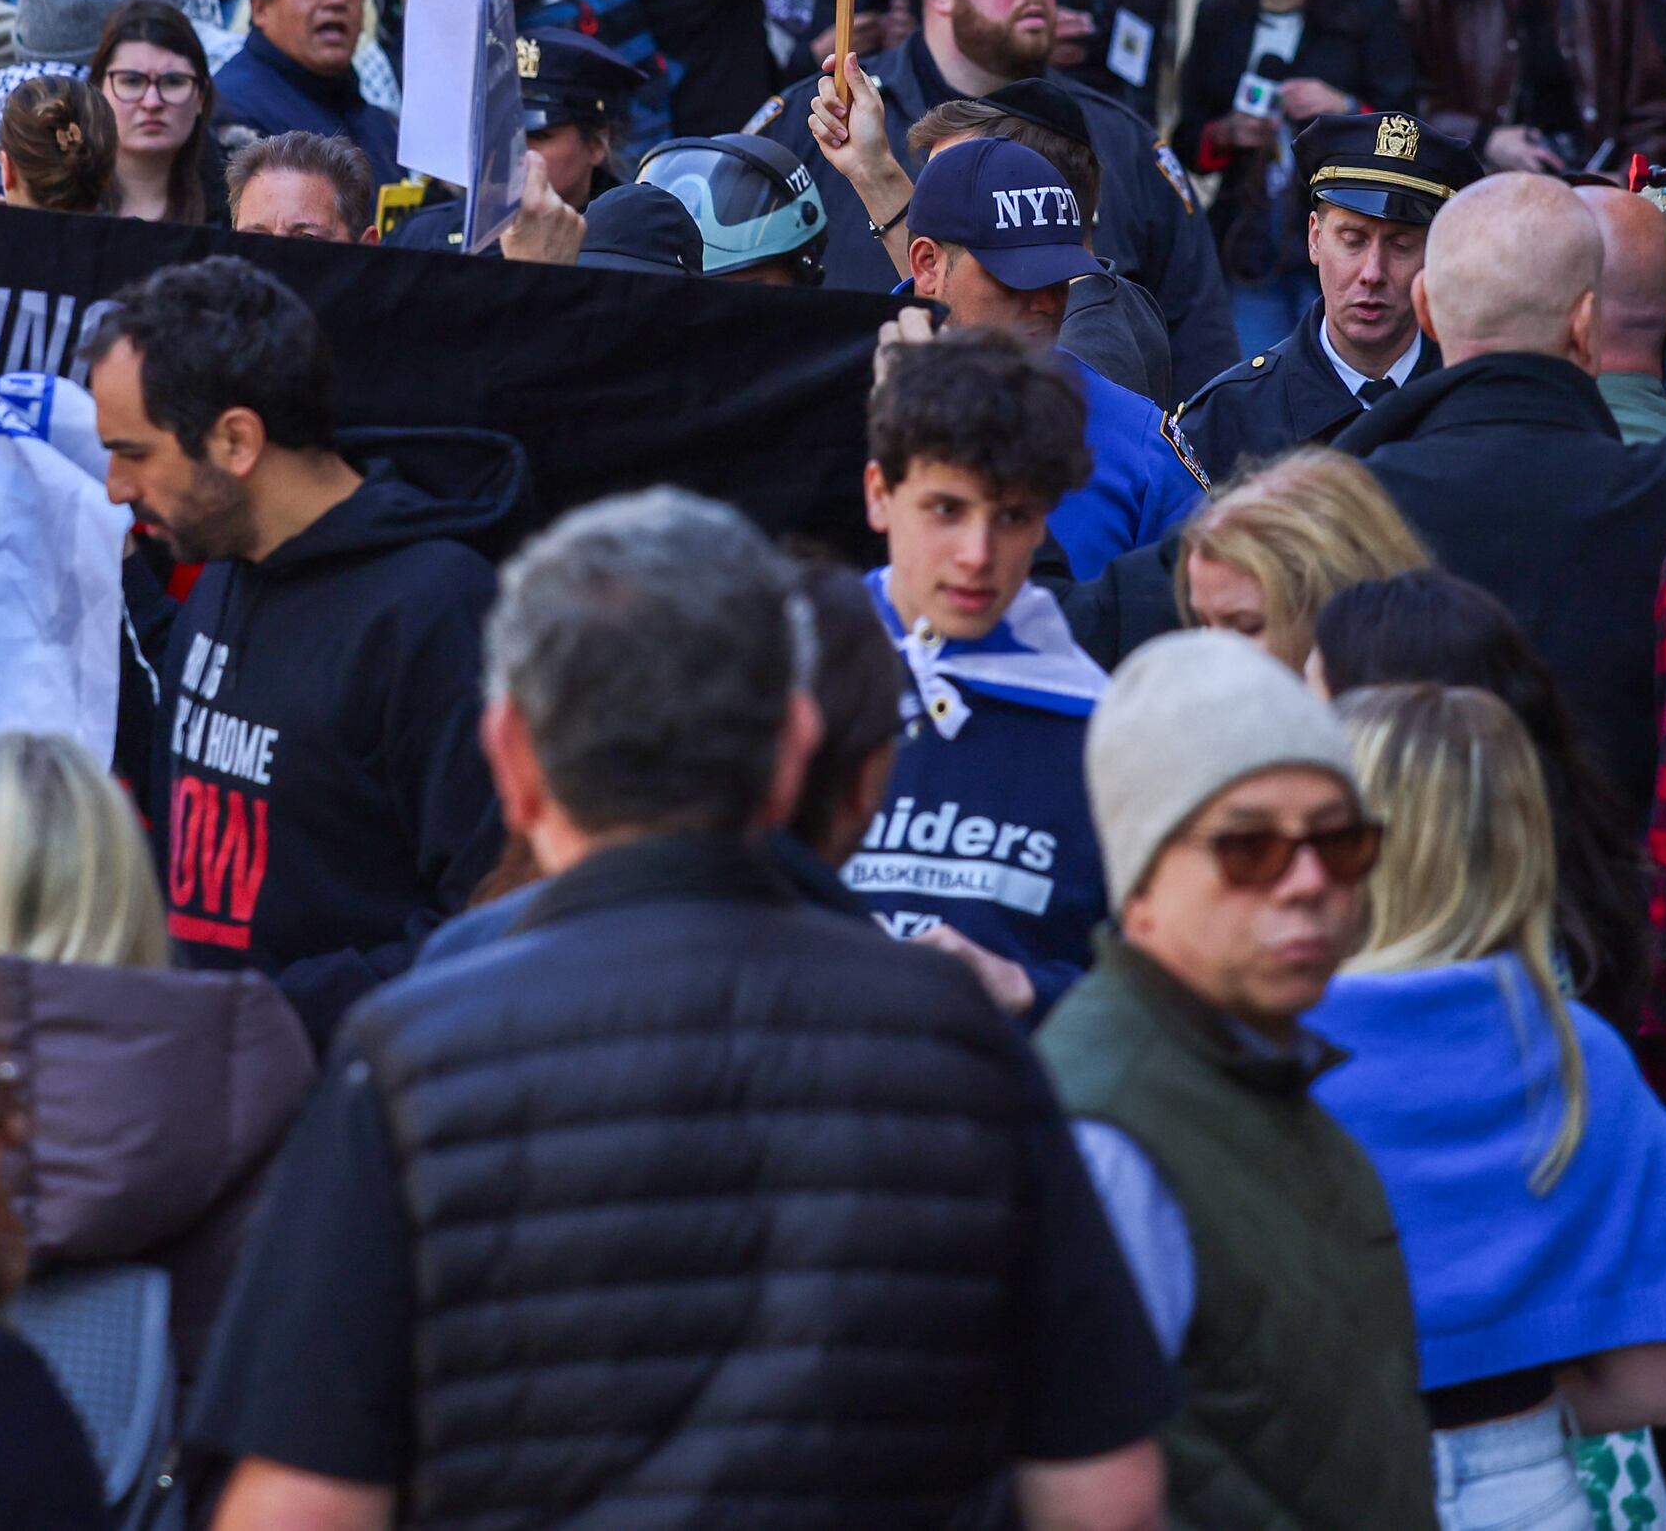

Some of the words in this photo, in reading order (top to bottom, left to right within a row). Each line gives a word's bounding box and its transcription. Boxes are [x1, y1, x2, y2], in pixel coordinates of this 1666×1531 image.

[203, 710, 279, 786] HOME
[169, 774, 269, 922] OW
[853, 862, 994, 891] BASKETBALL
